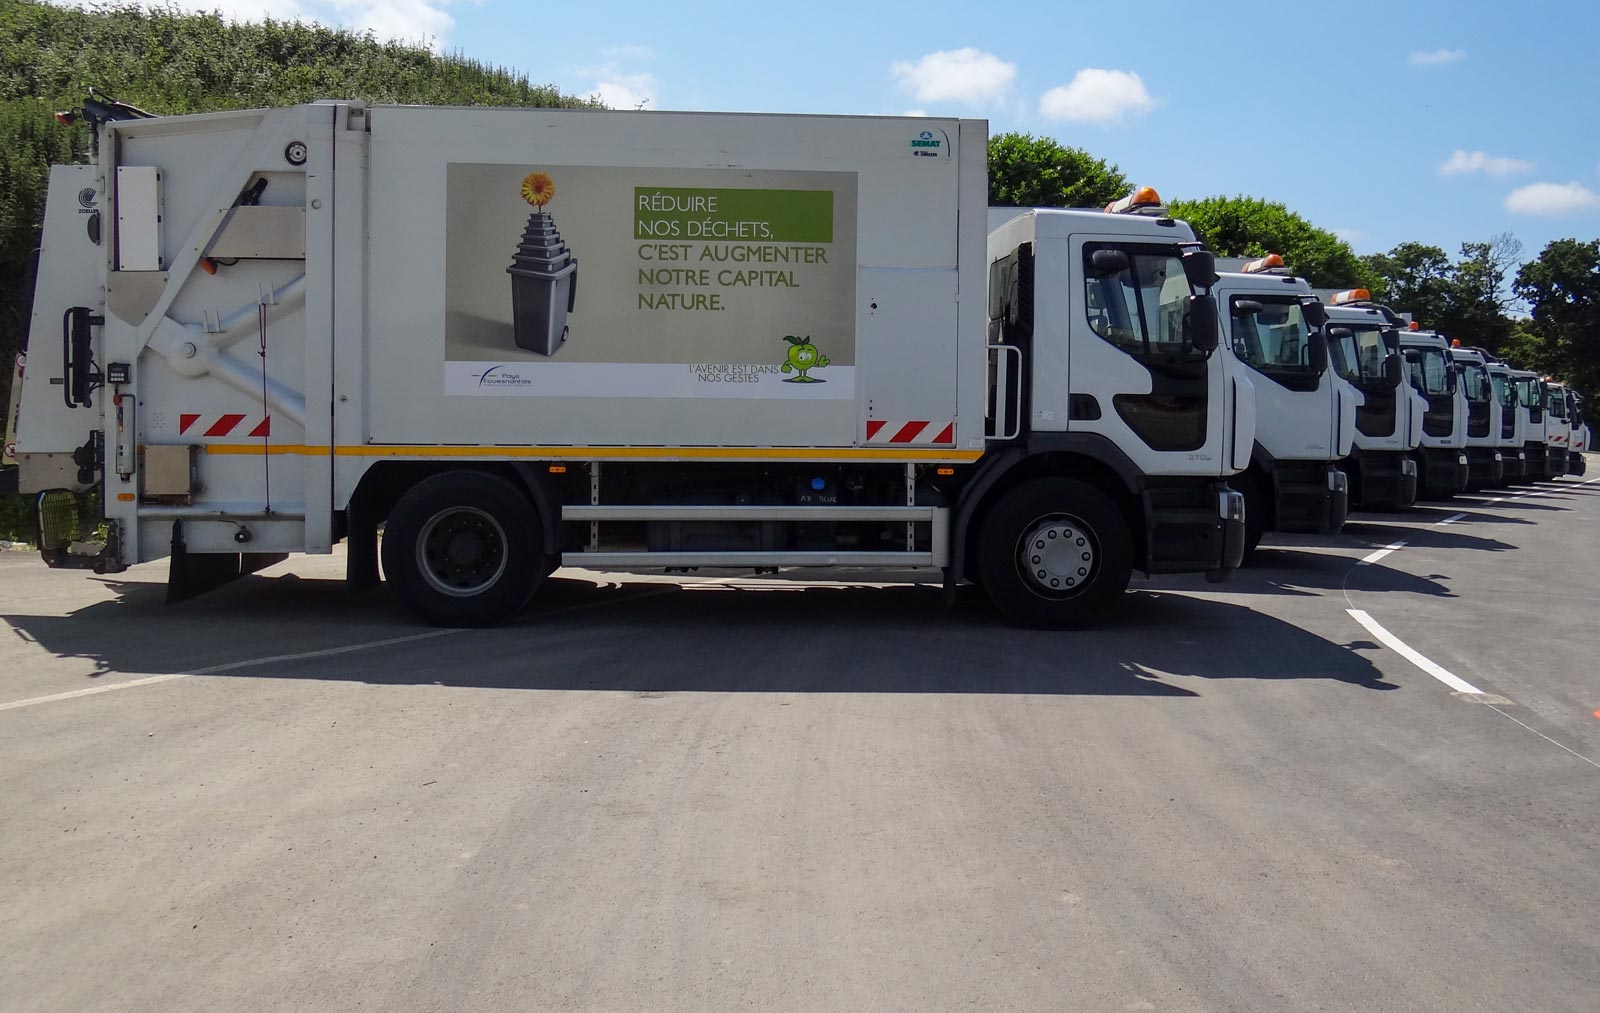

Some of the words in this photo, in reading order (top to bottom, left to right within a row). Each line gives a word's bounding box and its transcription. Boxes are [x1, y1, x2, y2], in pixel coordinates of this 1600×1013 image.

[911, 140, 941, 148] SEMAT
[638, 191, 718, 213] RÉDUIRE
[638, 220, 680, 236] NOS
[687, 217, 774, 239] DÉCHETS,
[638, 244, 692, 261] C'EST
[699, 245, 828, 264] AUGMENTER
[638, 269, 710, 286] NOTRE
[717, 270, 800, 288] CAPITAL
[638, 293, 725, 311] NATURE.
[689, 364, 729, 374] L'AVENIR
[732, 364, 747, 374] EST
[750, 365, 779, 375] DANS
[698, 373, 721, 383] NOS
[724, 373, 760, 383] GESTES
